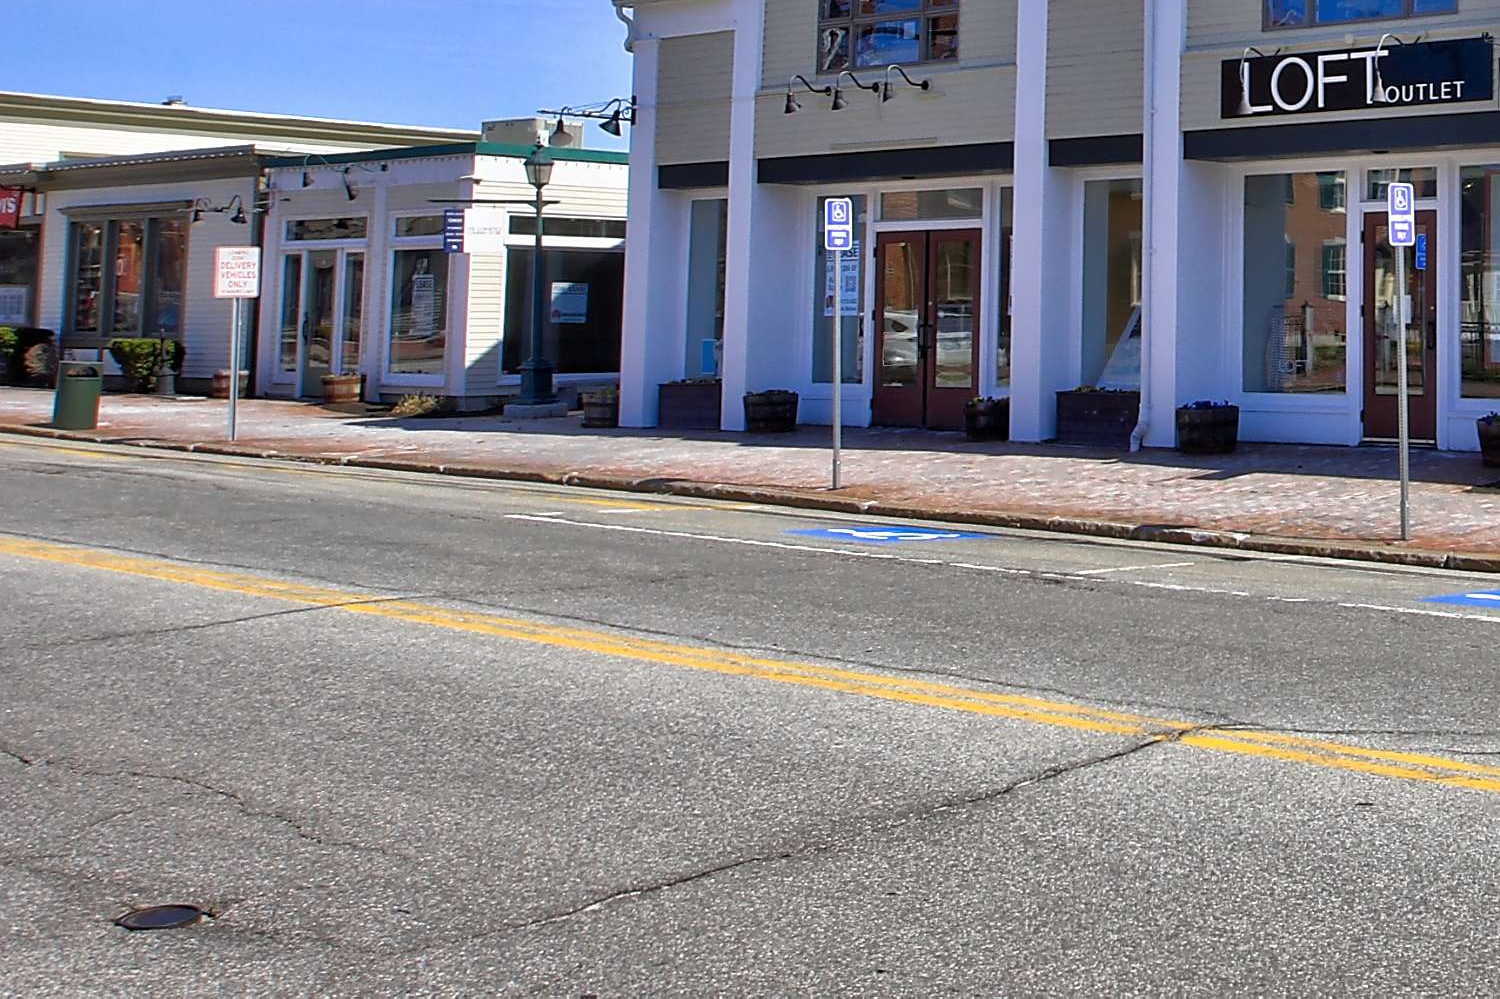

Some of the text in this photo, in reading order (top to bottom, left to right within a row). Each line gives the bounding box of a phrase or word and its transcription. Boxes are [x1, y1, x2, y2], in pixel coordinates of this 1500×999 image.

[1242, 49, 1465, 114] LOFT OUTLET
[220, 261, 256, 270] DELIVERY
[220, 270, 257, 279] VEHICLES
[227, 280, 248, 288] ONLY
